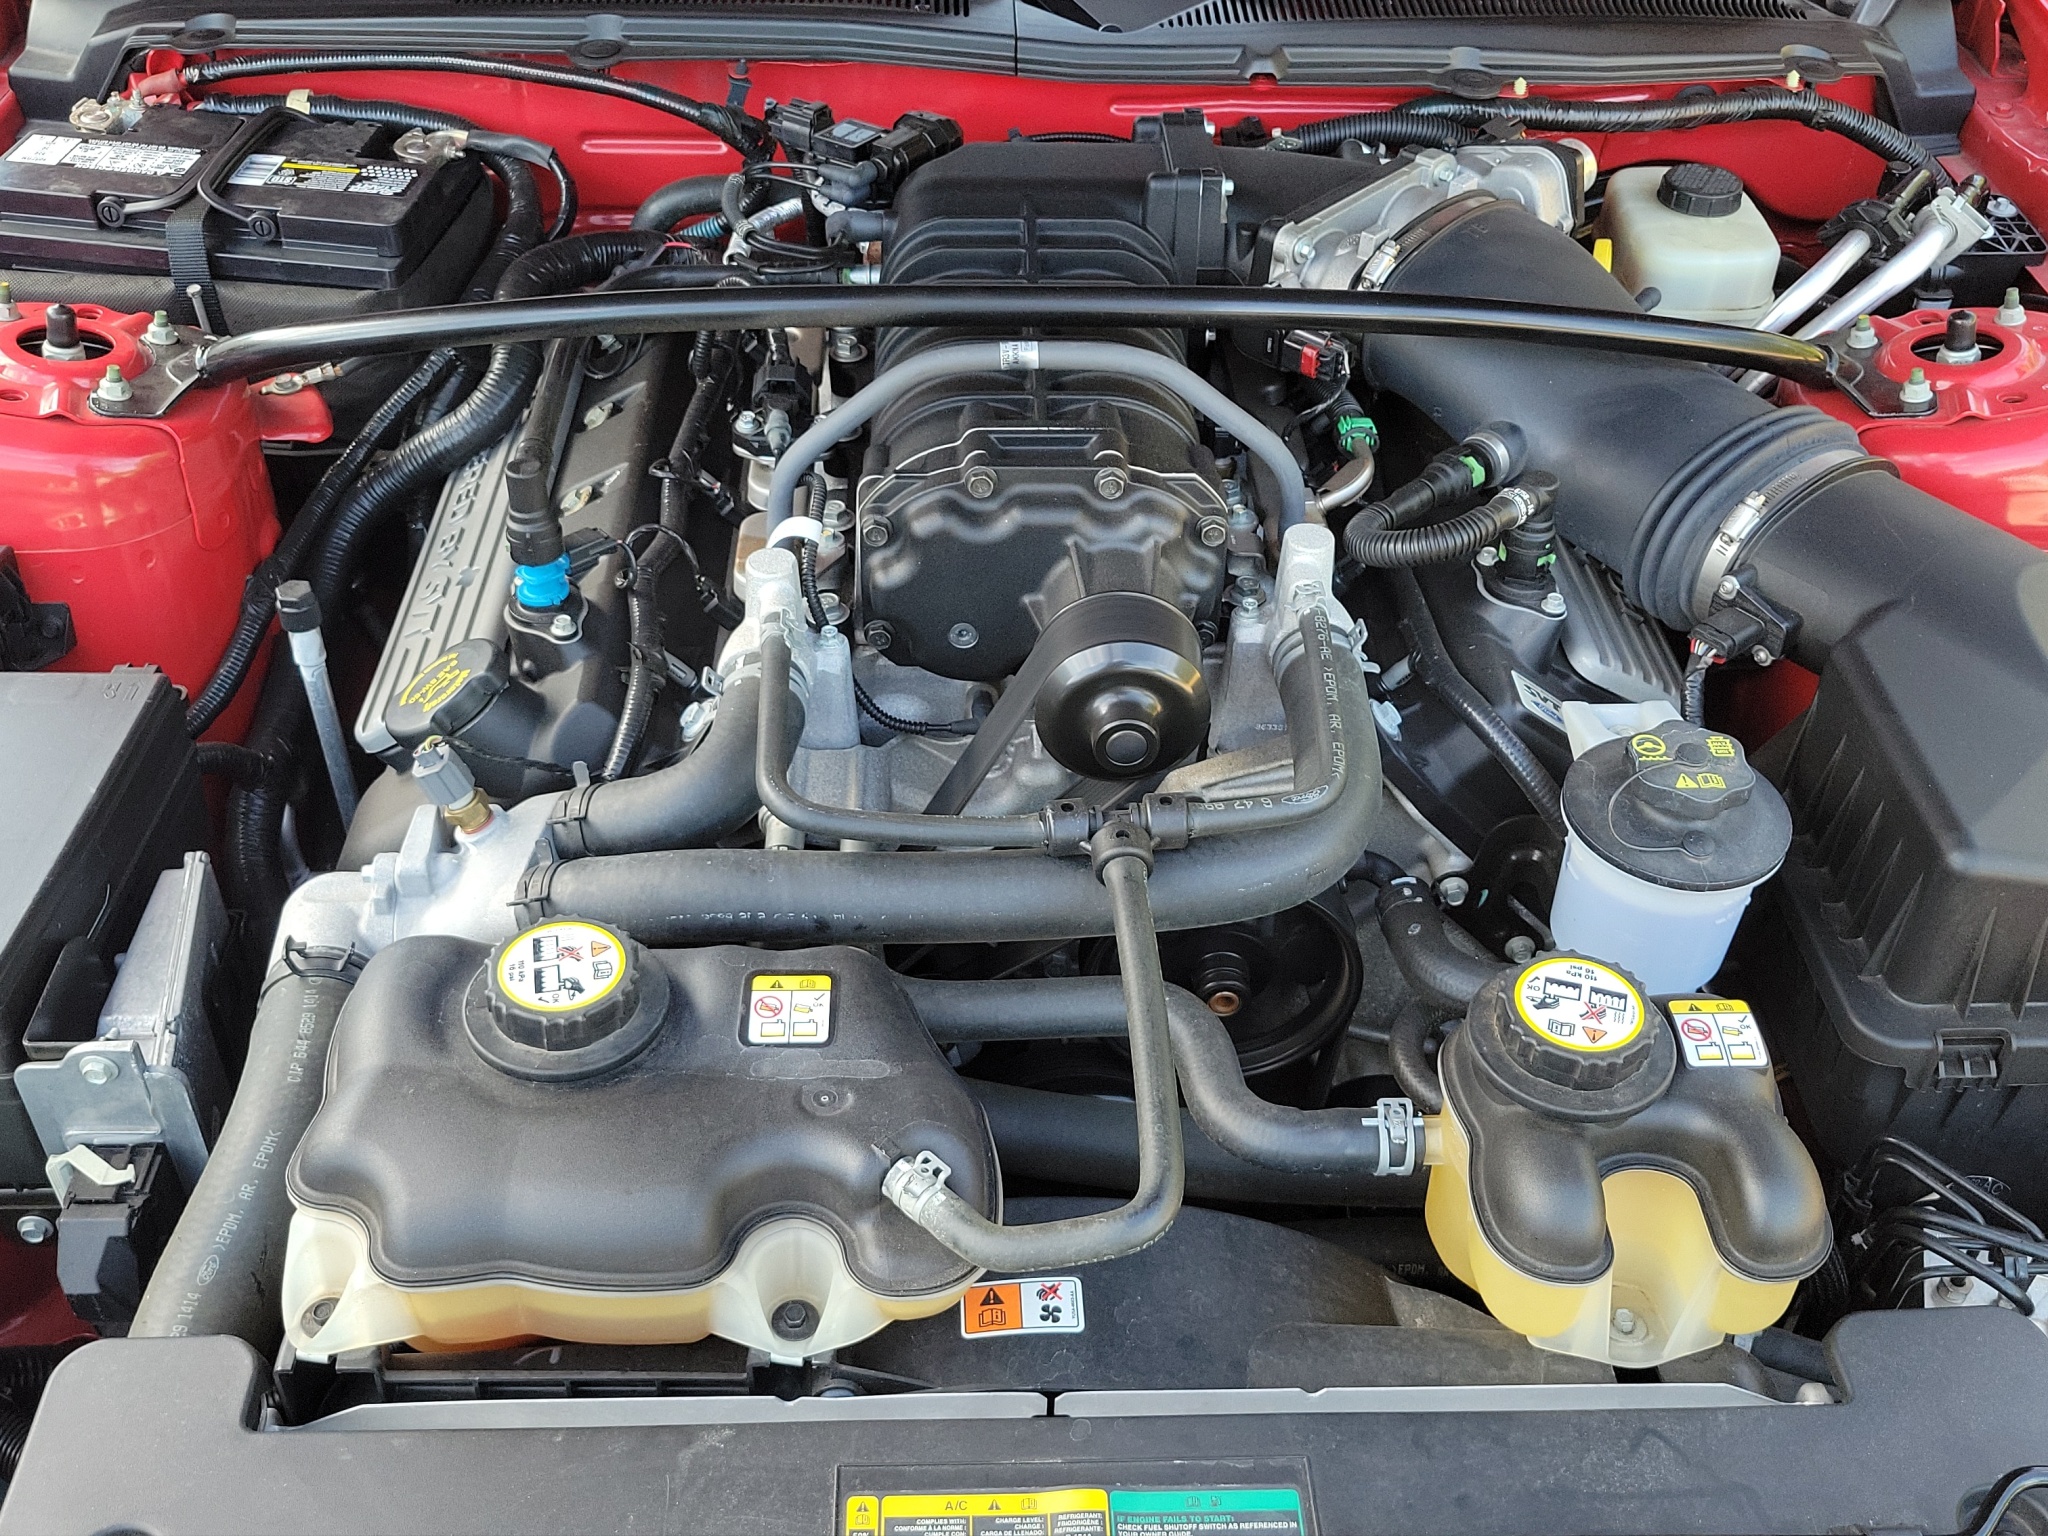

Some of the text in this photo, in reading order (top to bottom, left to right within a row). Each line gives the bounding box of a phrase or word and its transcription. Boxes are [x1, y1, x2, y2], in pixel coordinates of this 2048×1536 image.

[432, 527, 466, 570] BY
[405, 576, 451, 638] SVT
[552, 993, 559, 1003] OK
[299, 1012, 316, 1034] 8529
[177, 1291, 202, 1321] 1414
[239, 1179, 259, 1200] AR,
[944, 1500, 968, 1511] A/C
[1116, 1515, 1125, 1523] IF
[1127, 1515, 1161, 1523] ENGINE
[1163, 1515, 1187, 1523] FAILS
[1144, 1523, 1163, 1531] FUEL
[1163, 1523, 1197, 1531] SHUTOFF
[1198, 1522, 1227, 1530] SWITCH
[1228, 1522, 1239, 1530] AS
[1239, 1521, 1289, 1529] REFERENCED
